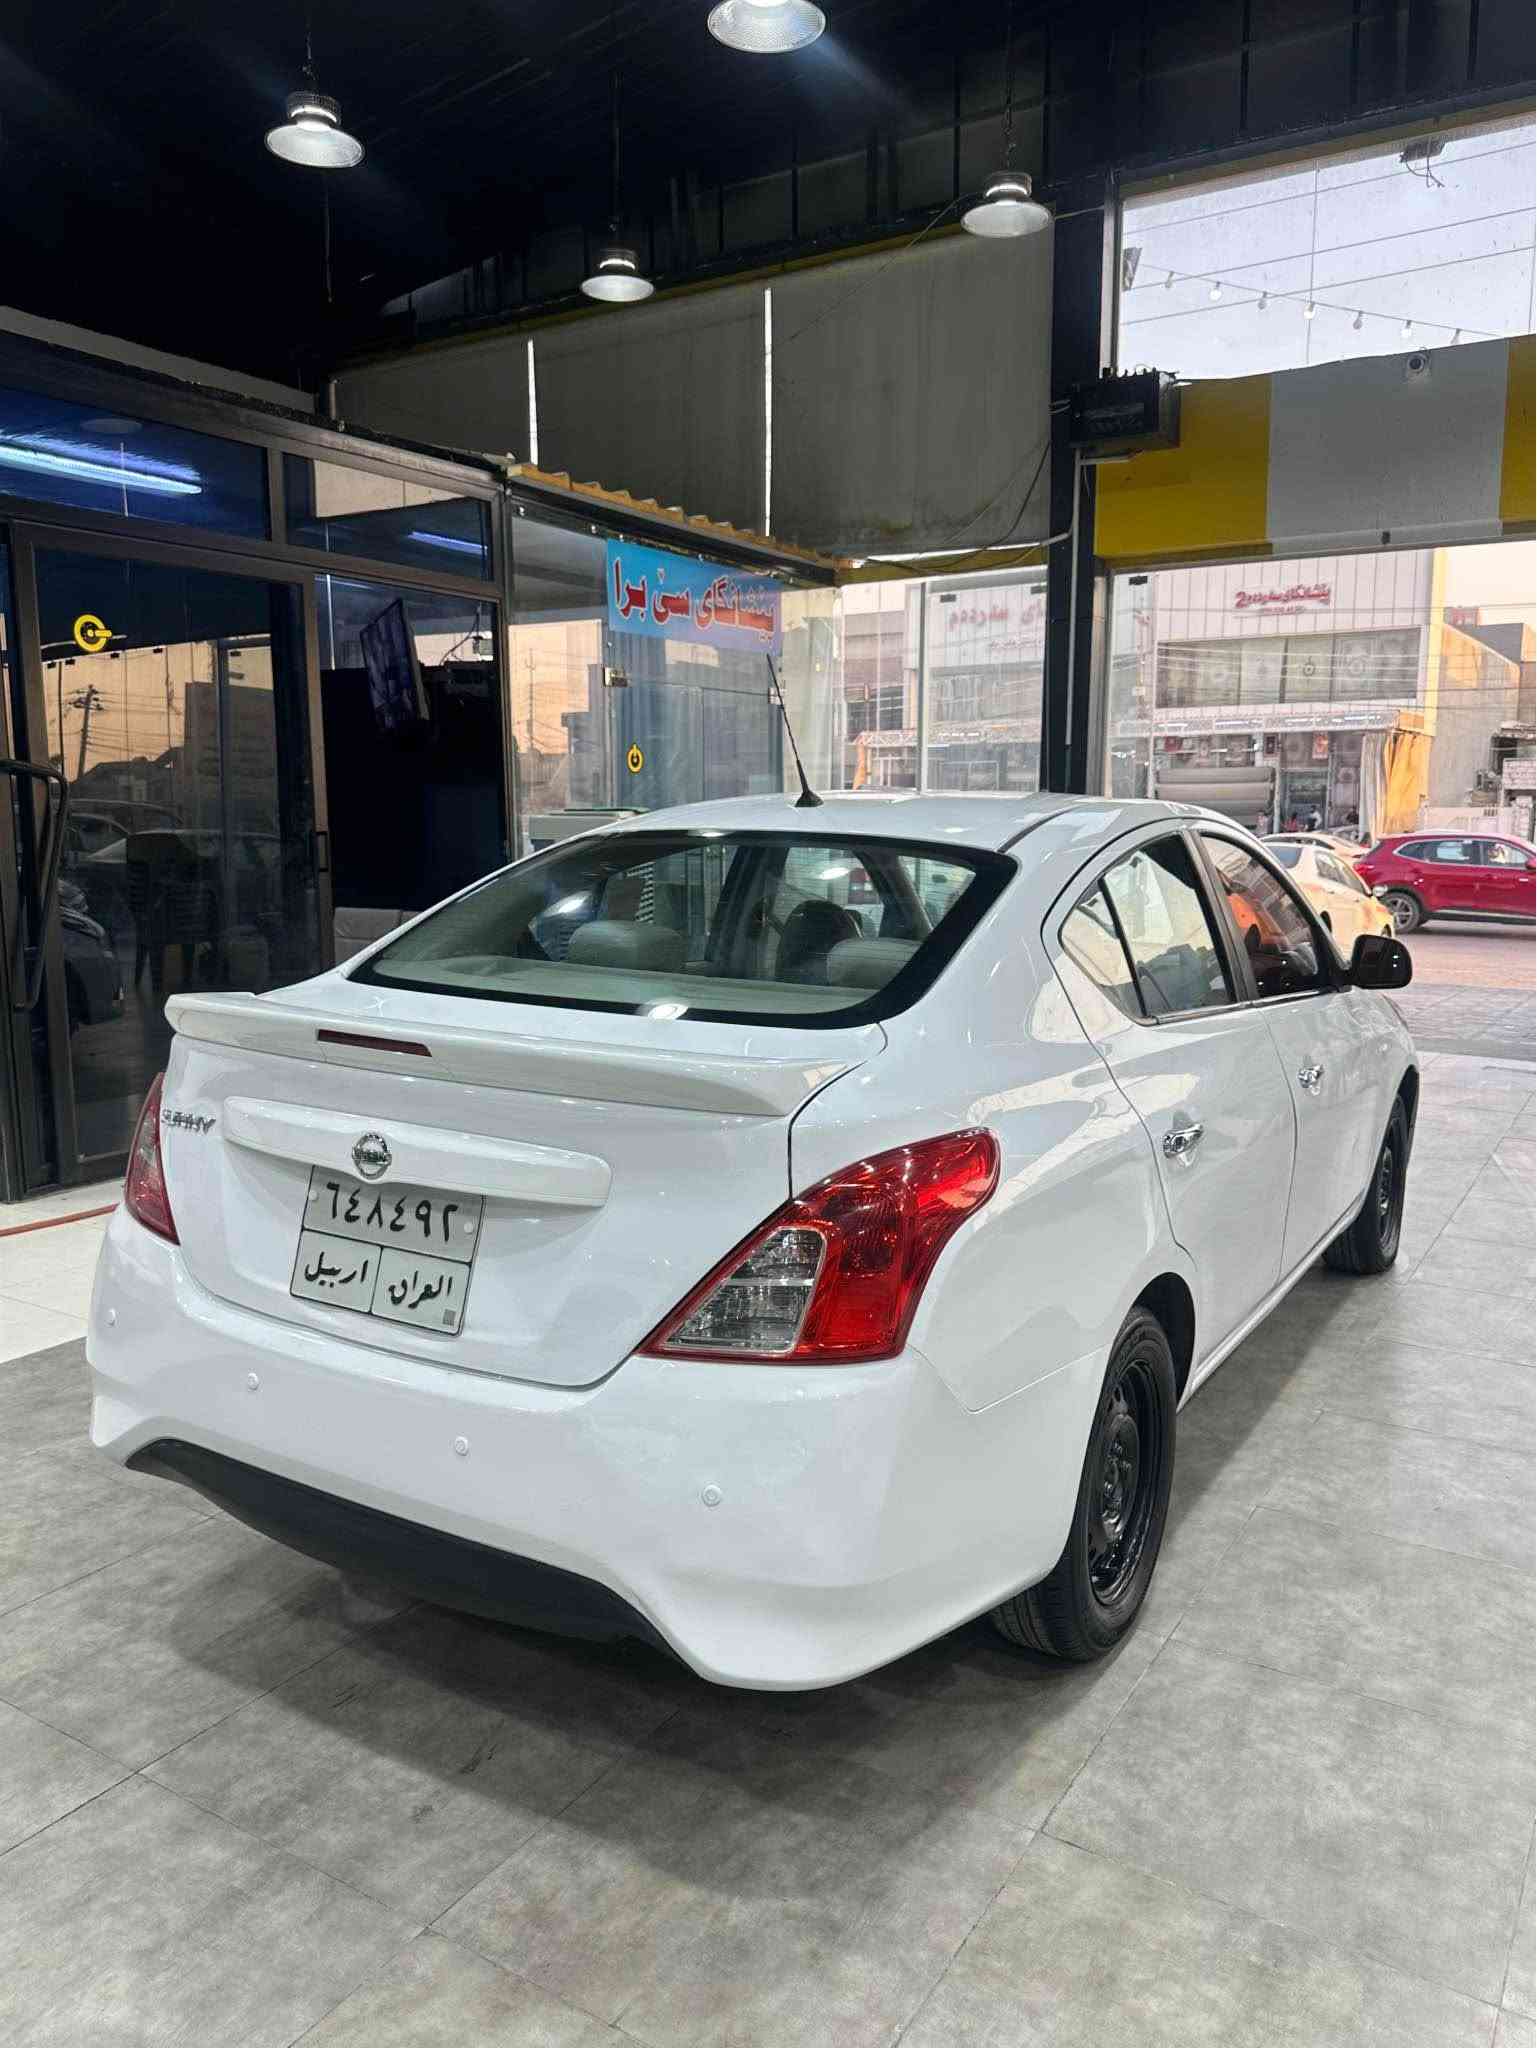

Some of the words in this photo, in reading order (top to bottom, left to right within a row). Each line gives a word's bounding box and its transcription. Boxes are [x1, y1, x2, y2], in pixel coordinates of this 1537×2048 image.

[613, 557, 647, 622] برا
[326, 1181, 459, 1242] ٦٤٨٤٩٢
[304, 1251, 369, 1288] اربيل
[388, 1270, 453, 1309] العراق
